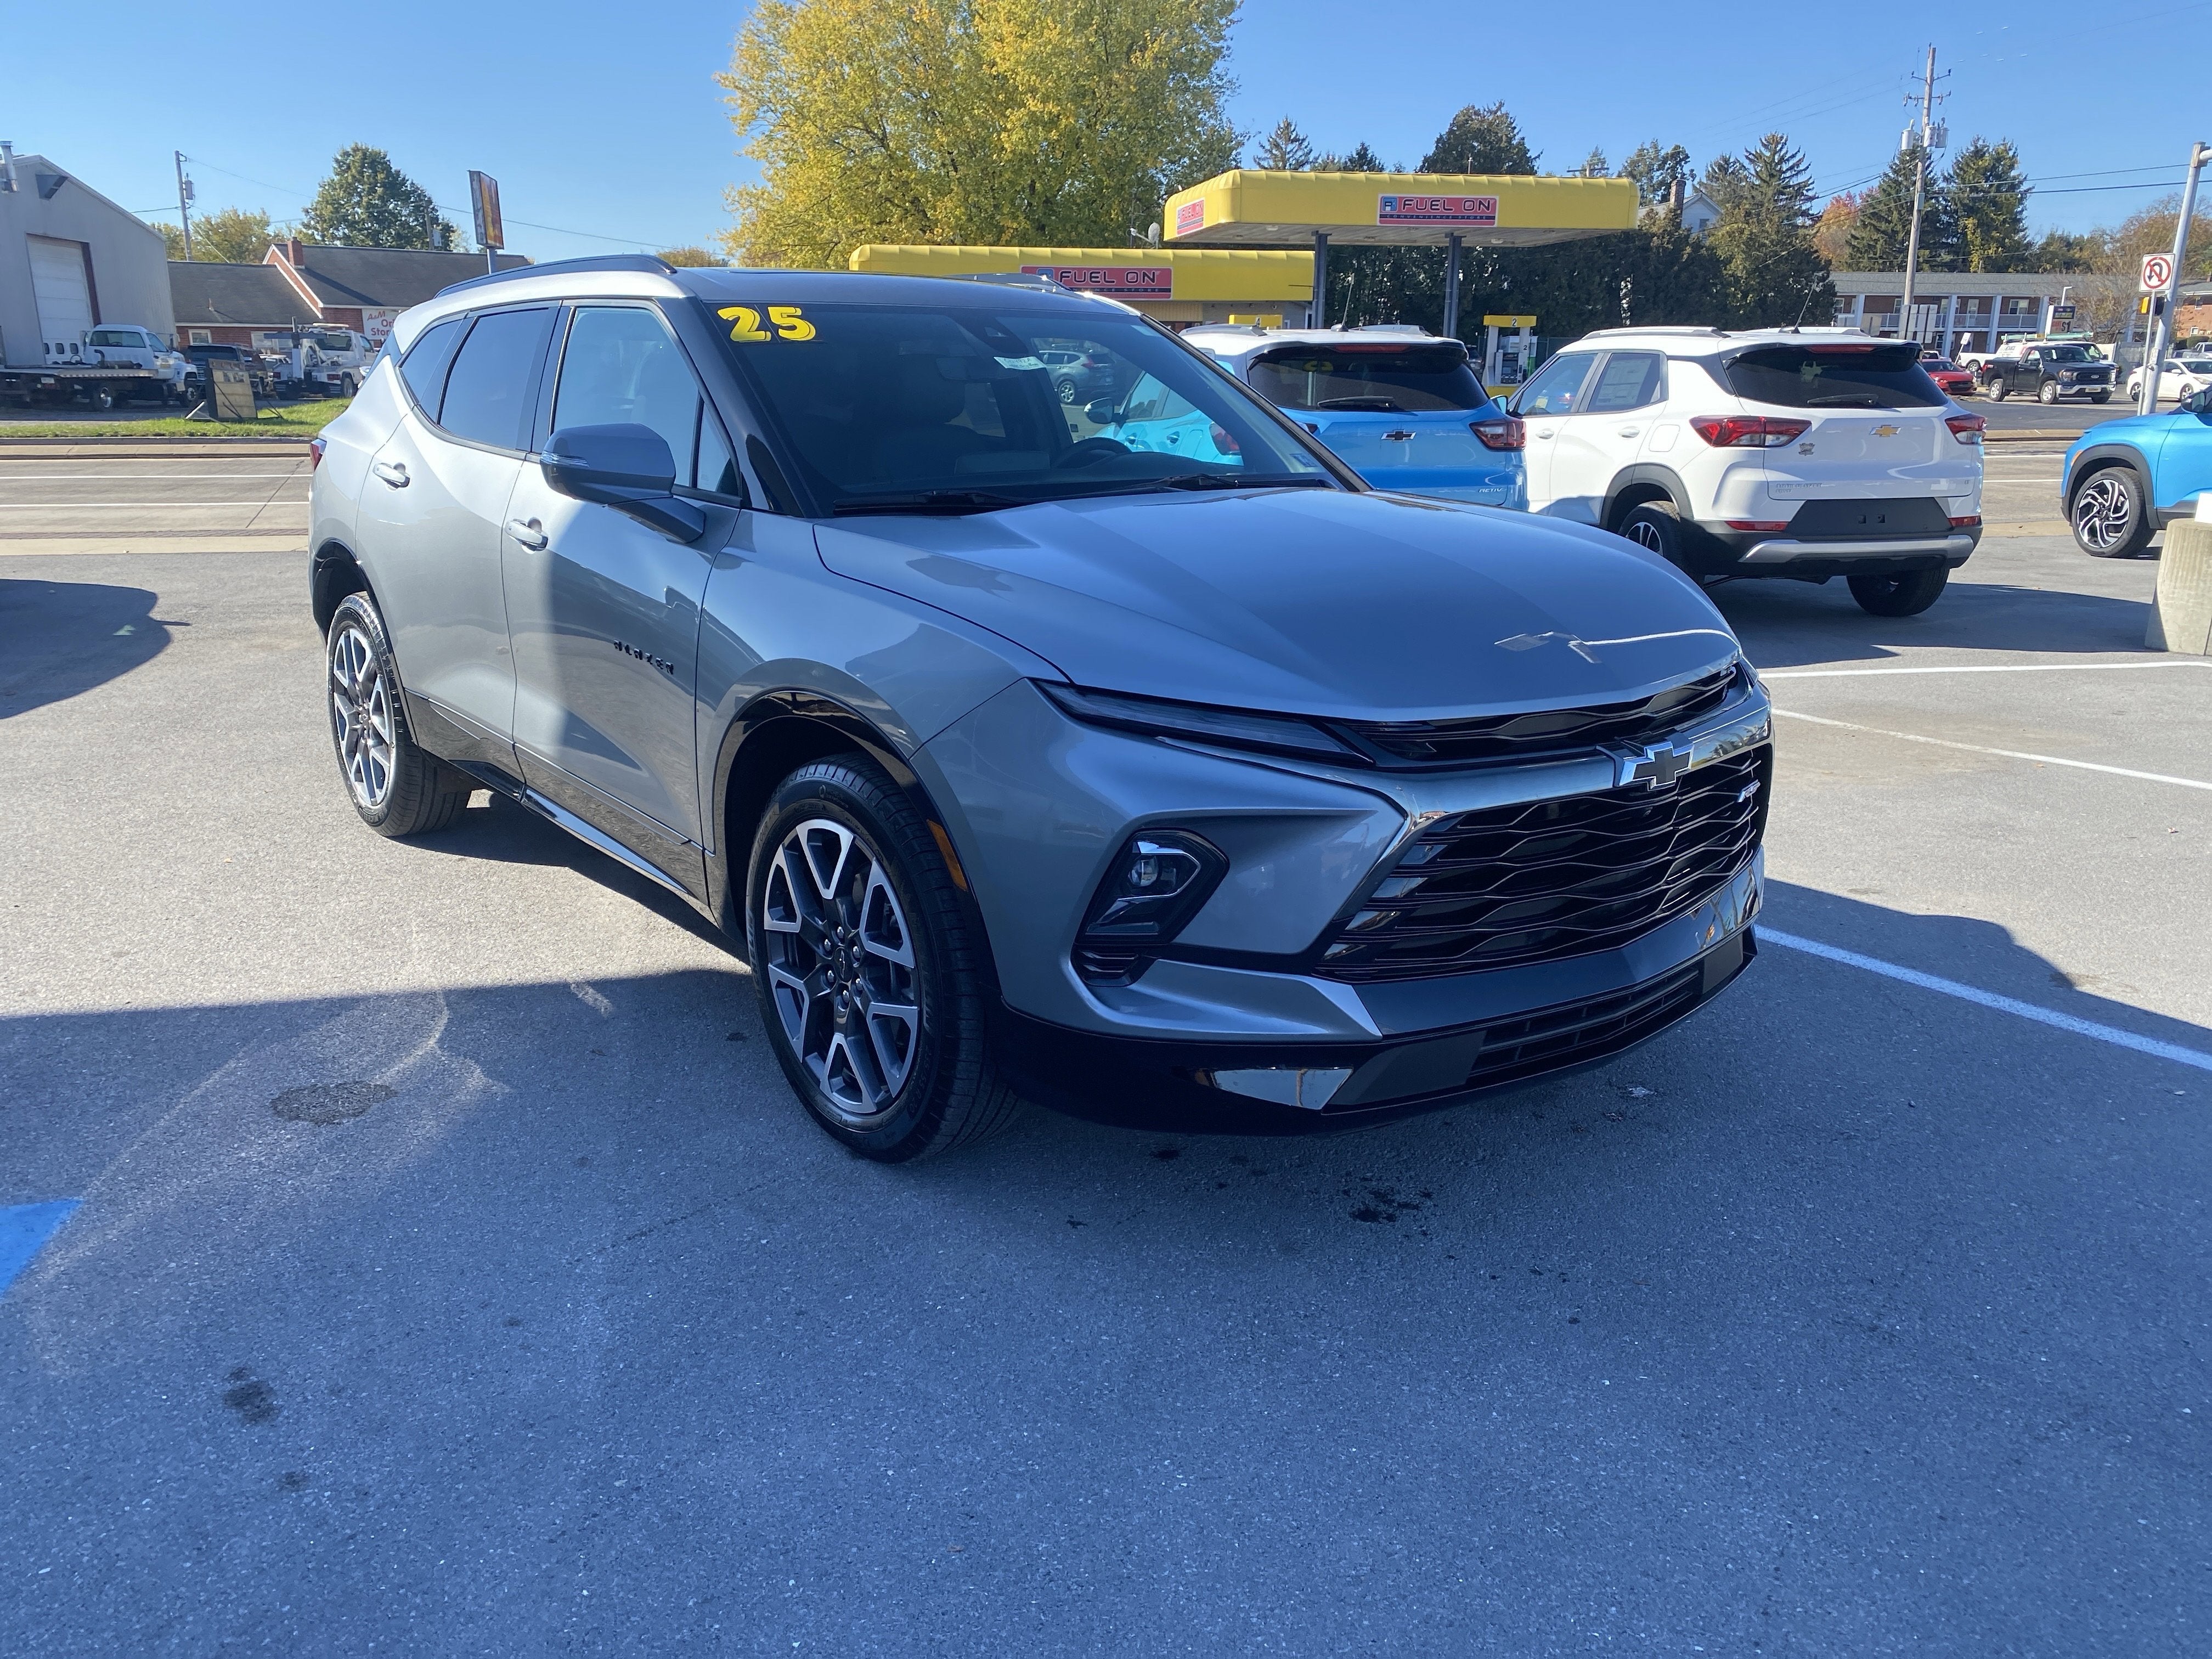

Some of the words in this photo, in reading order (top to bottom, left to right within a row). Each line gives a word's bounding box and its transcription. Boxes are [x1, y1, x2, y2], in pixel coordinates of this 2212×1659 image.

[1402, 199, 1454, 211] FUEL
[1463, 200, 1490, 211] ON
[1182, 207, 1194, 219] FUEL
[1059, 271, 1115, 283] FUEL
[1126, 272, 1155, 283] ON
[716, 306, 816, 343] 25
[1513, 318, 1517, 326] 2
[613, 640, 674, 675] BLAZER
[756, 821, 769, 850] TOUR
